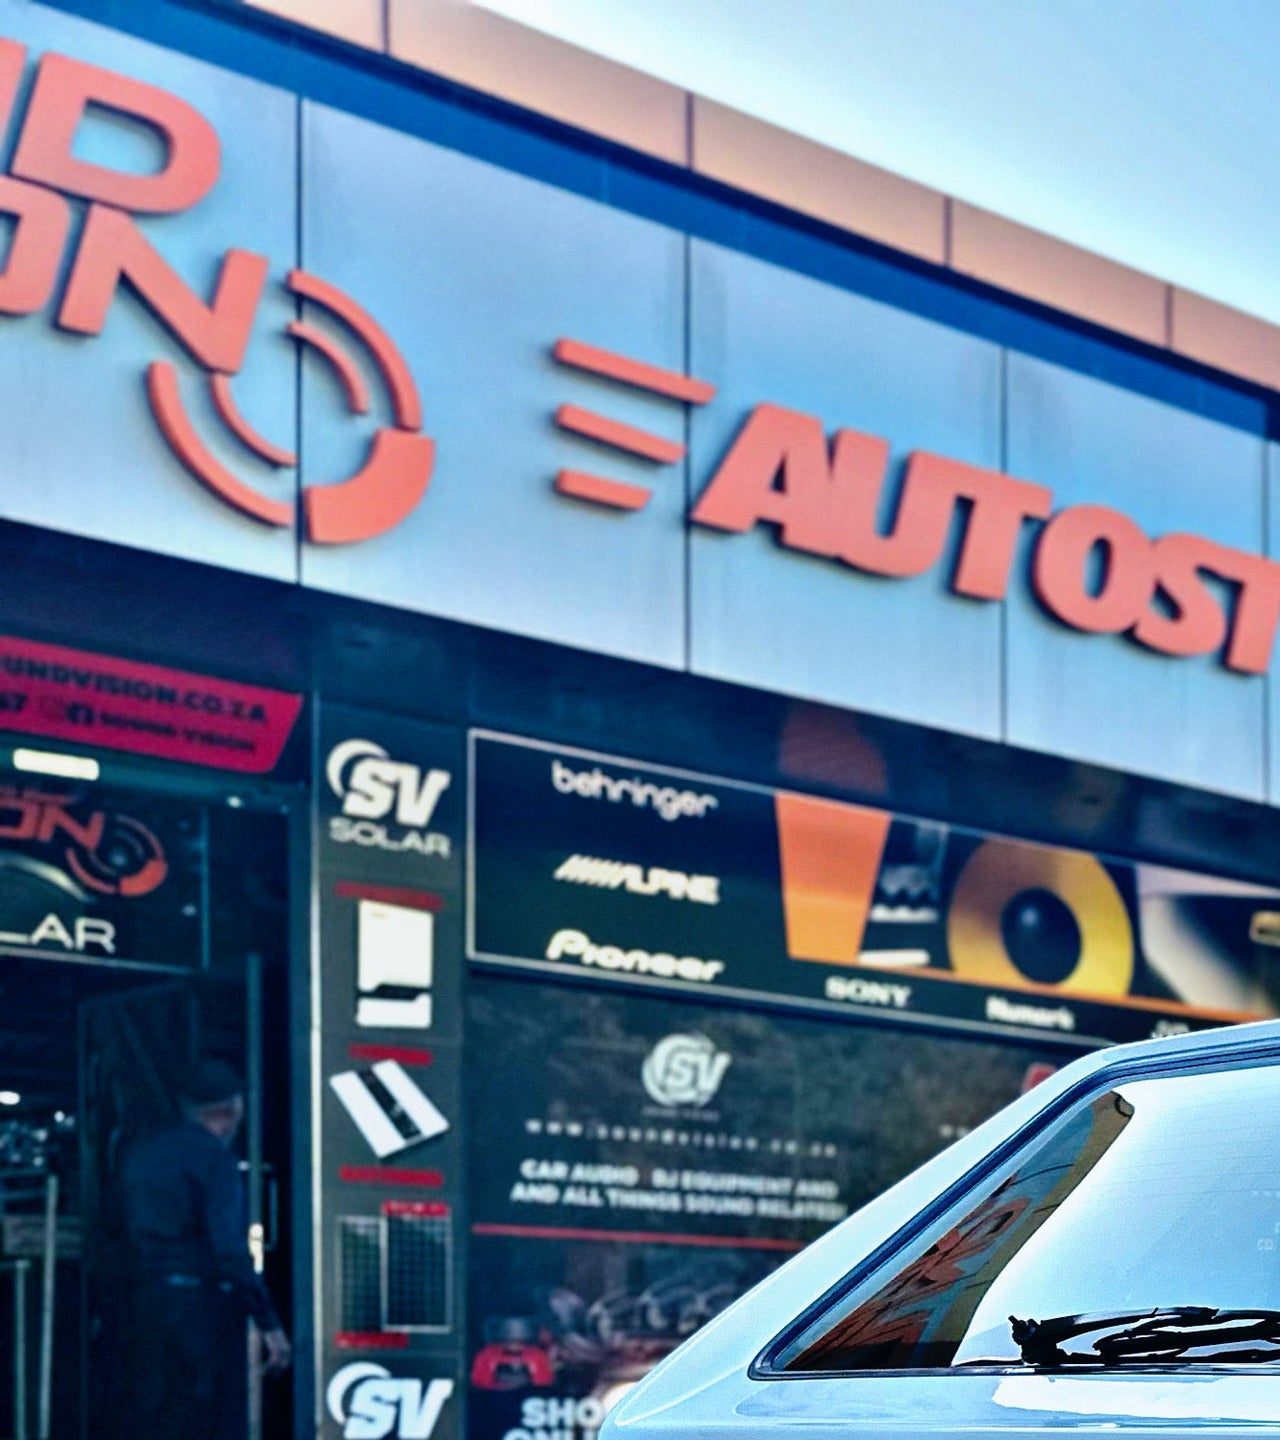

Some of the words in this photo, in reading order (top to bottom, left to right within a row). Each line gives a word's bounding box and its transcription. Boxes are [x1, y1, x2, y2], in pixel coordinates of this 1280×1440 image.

[0, 38, 222, 214] D
[552, 760, 719, 822] behringer
[329, 816, 450, 859] SOLAR
[546, 929, 725, 981] Pioneer
[826, 976, 911, 1008] SONY
[519, 1158, 569, 1181] CAR
[510, 1181, 560, 1205] AND
[563, 1184, 604, 1208] ALL
[341, 1378, 454, 1440] SV
